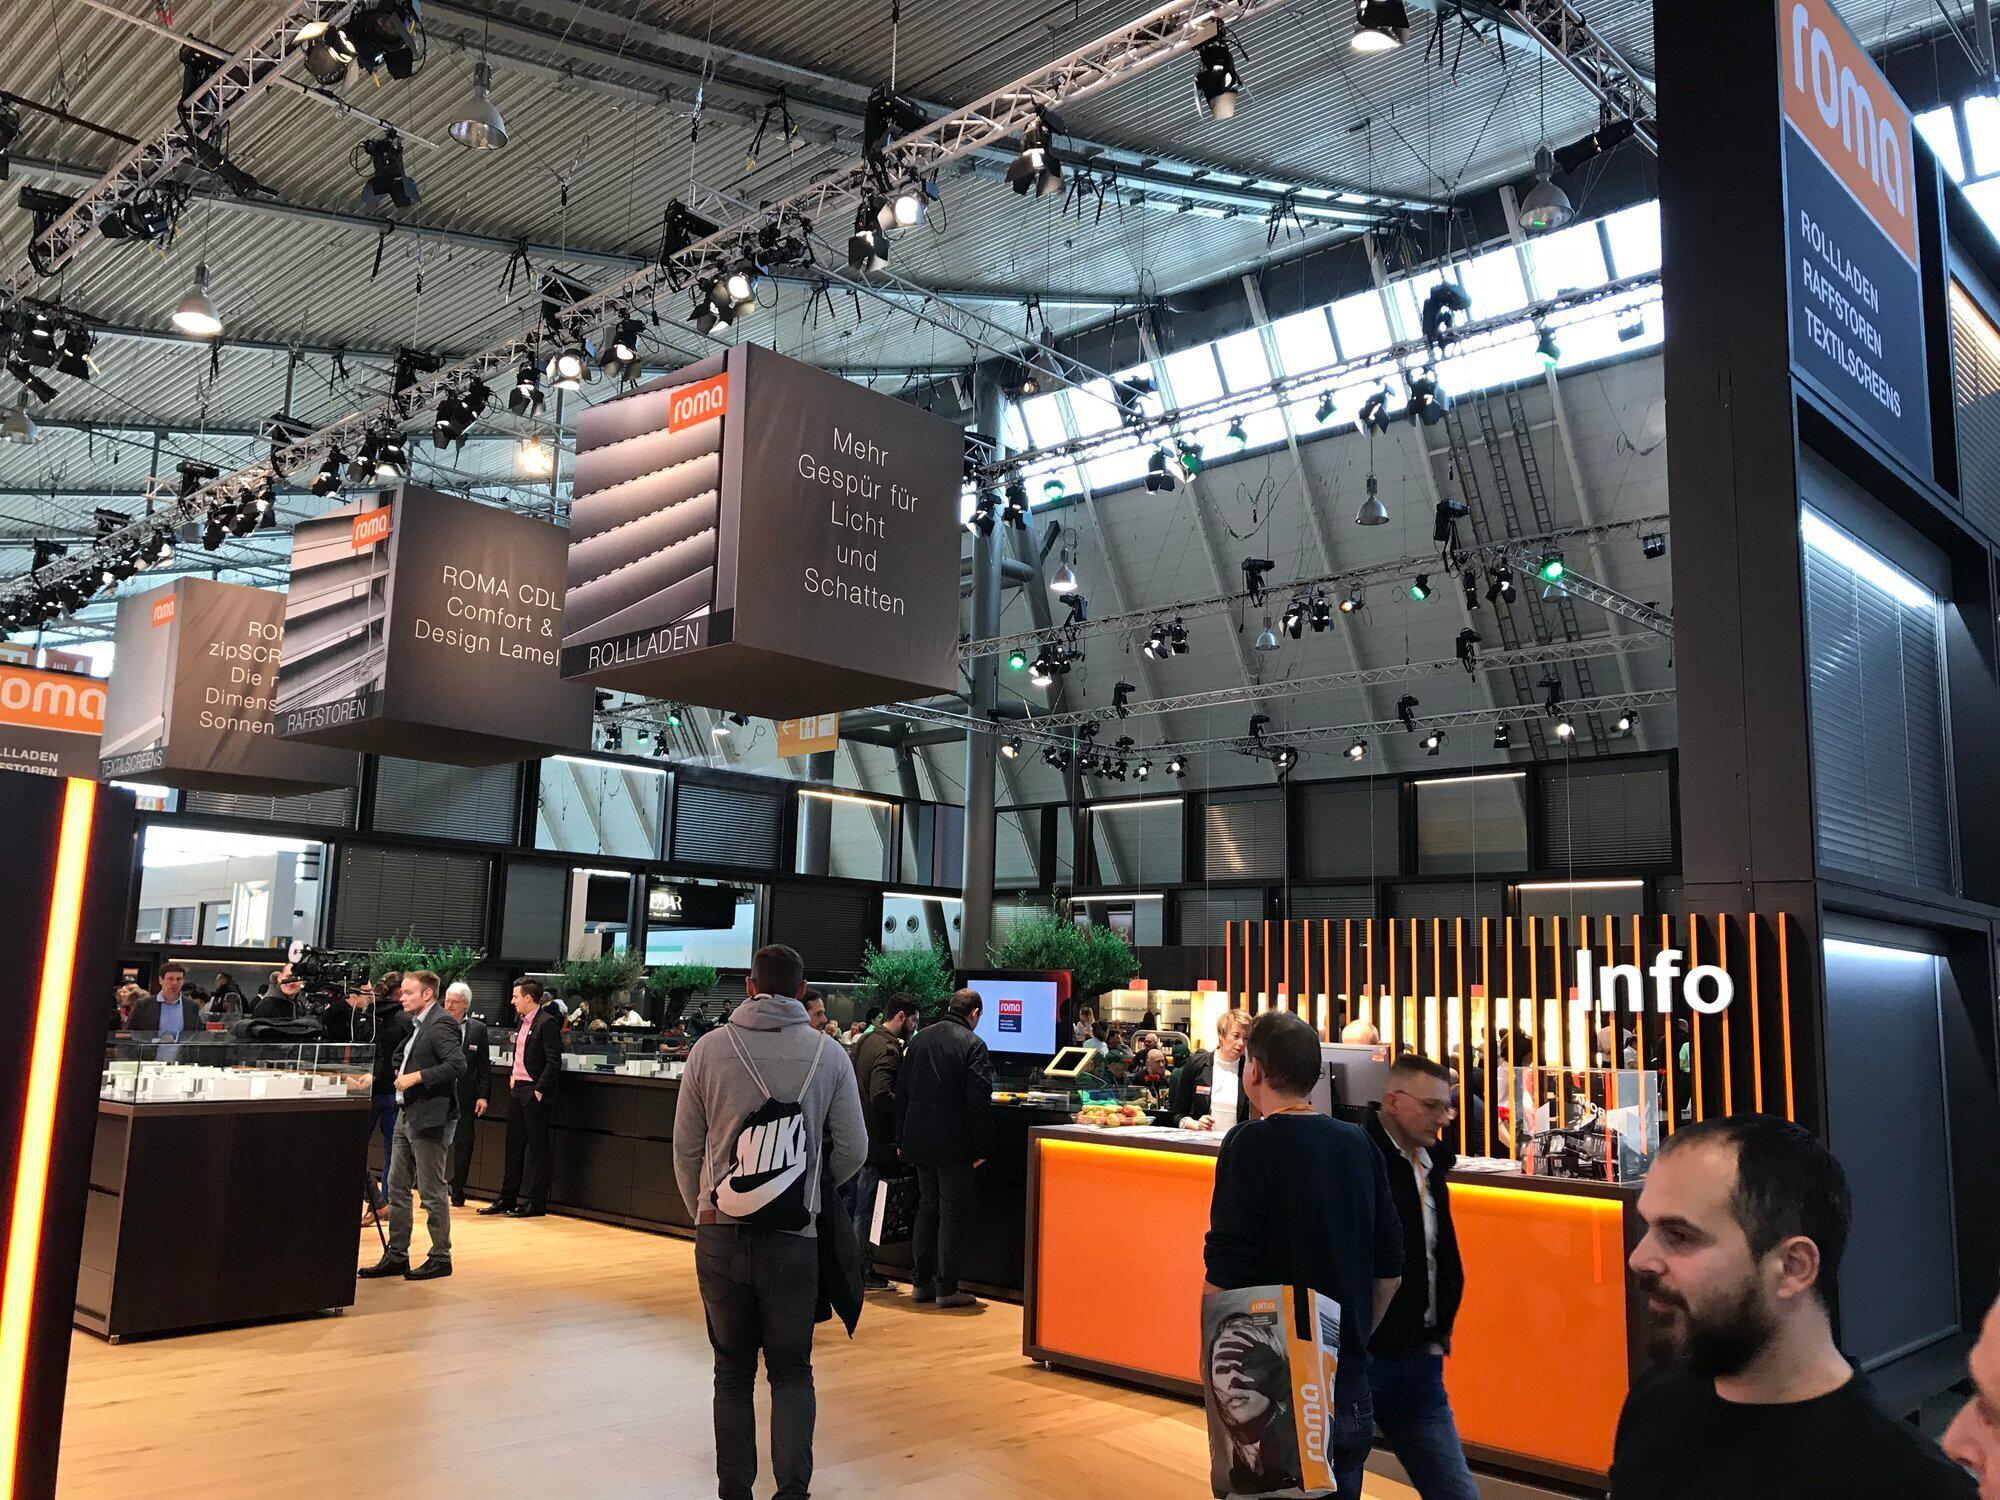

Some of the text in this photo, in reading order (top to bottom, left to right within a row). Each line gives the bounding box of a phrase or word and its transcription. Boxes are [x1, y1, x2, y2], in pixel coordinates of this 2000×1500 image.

[1792, 3, 1906, 217] roma
[1801, 209, 1879, 314] ROLLLADEN
[1803, 257, 1882, 360] RAFFSTOREN
[1805, 306, 1901, 418] TEXTILSCREENS
[673, 384, 723, 425] roma
[833, 427, 889, 467] Mehr
[798, 453, 919, 513] Gespür für
[354, 512, 388, 542] roma
[830, 500, 886, 539] Licht
[836, 544, 877, 572] und
[442, 565, 562, 611] ROMA CDL
[803, 567, 906, 616] Schatten
[153, 600, 175, 621] roma
[447, 596, 554, 638] Comfort &
[415, 618, 490, 653] Design
[588, 621, 699, 670] ROLLLADEN
[231, 666, 262, 686] Die
[0, 675, 107, 720] oma
[205, 687, 277, 712] Dimens
[287, 698, 366, 732] RAFFSTOREN
[199, 710, 275, 735] Sonnen
[0, 747, 59, 763] LLADEN
[1577, 949, 1734, 1014] Info
[1000, 1003, 1021, 1012] roma
[1301, 1383, 1325, 1463] roma
